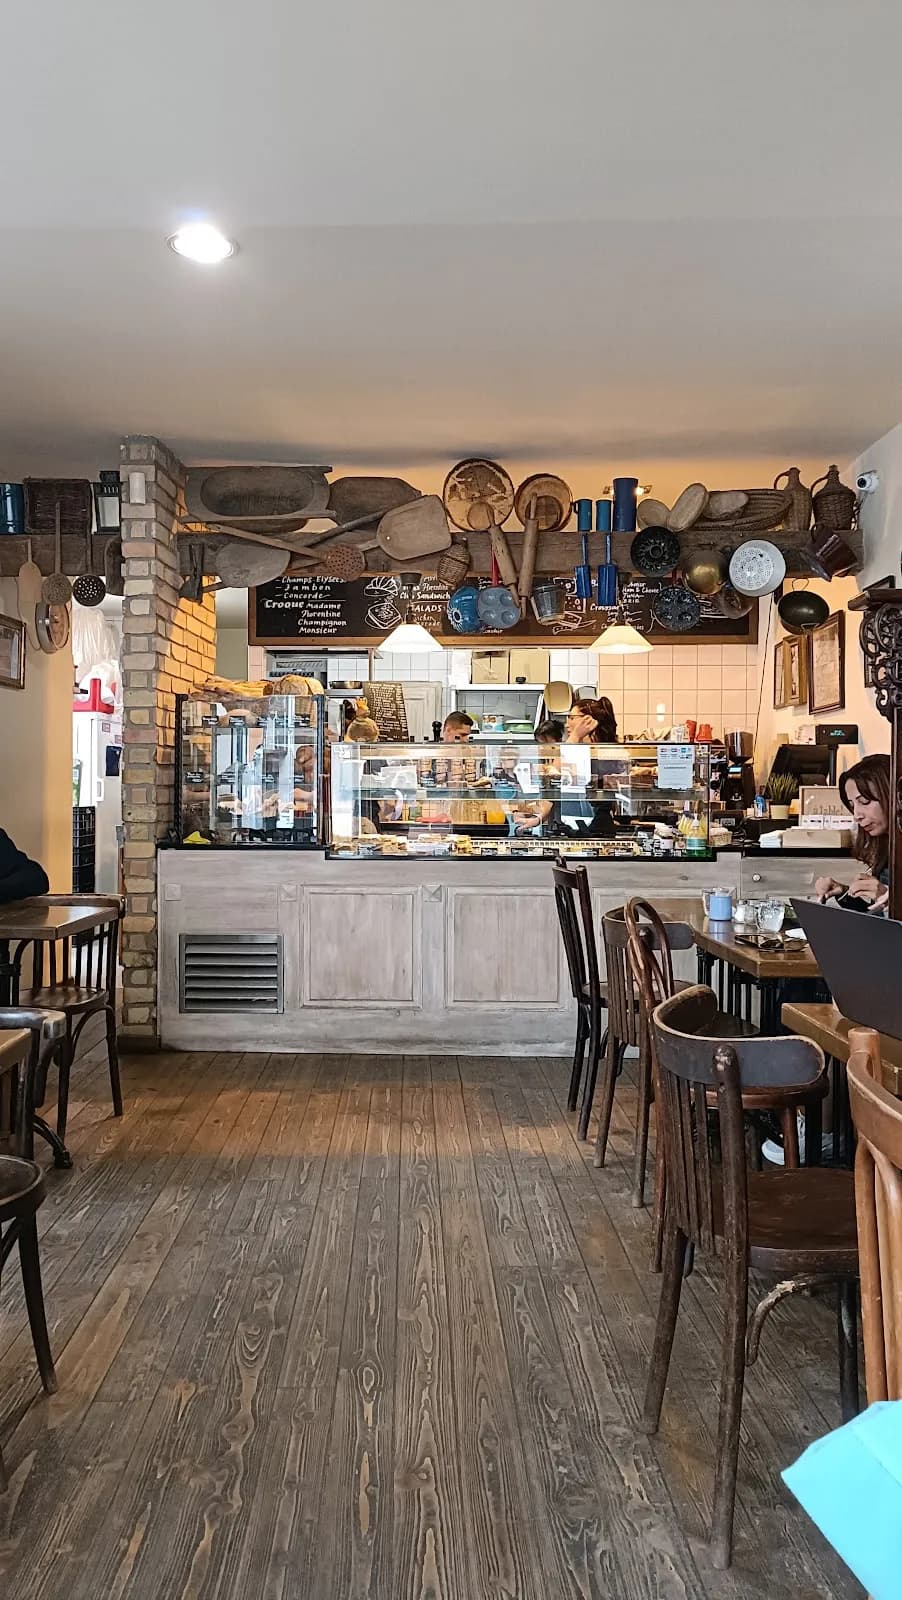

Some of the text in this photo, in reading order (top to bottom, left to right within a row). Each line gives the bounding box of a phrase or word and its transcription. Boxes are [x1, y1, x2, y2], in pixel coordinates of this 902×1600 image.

[264, 599, 305, 609] Croque
[301, 609, 341, 618] Florentine
[297, 618, 347, 627] Champignon
[298, 626, 338, 634] Monsieur
